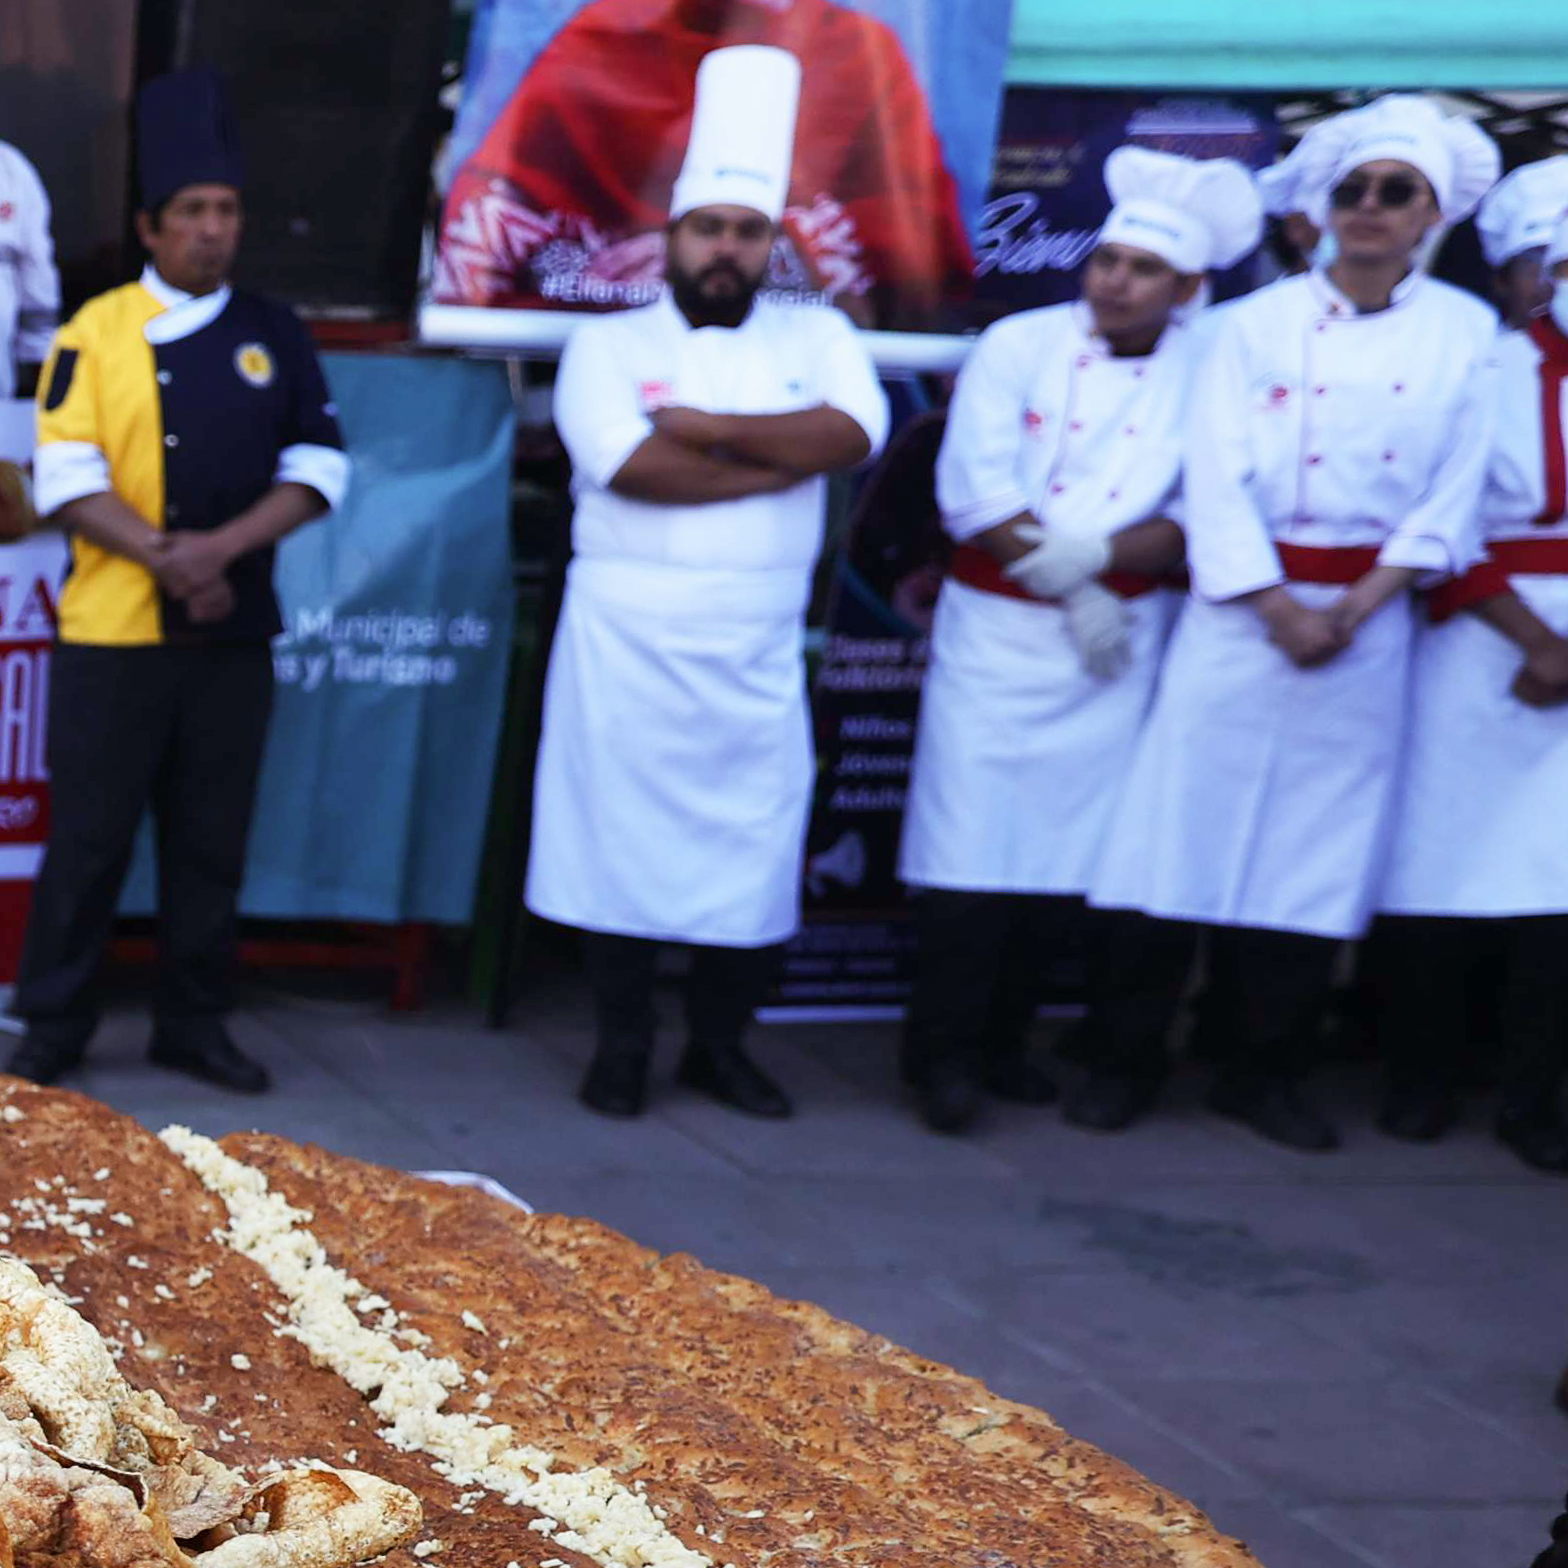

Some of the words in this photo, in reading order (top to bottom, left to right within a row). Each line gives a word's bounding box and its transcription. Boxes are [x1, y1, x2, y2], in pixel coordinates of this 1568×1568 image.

[295, 606, 446, 648] Municipal
[448, 610, 491, 649] de
[299, 655, 330, 693] y
[333, 646, 459, 686] Turismo
